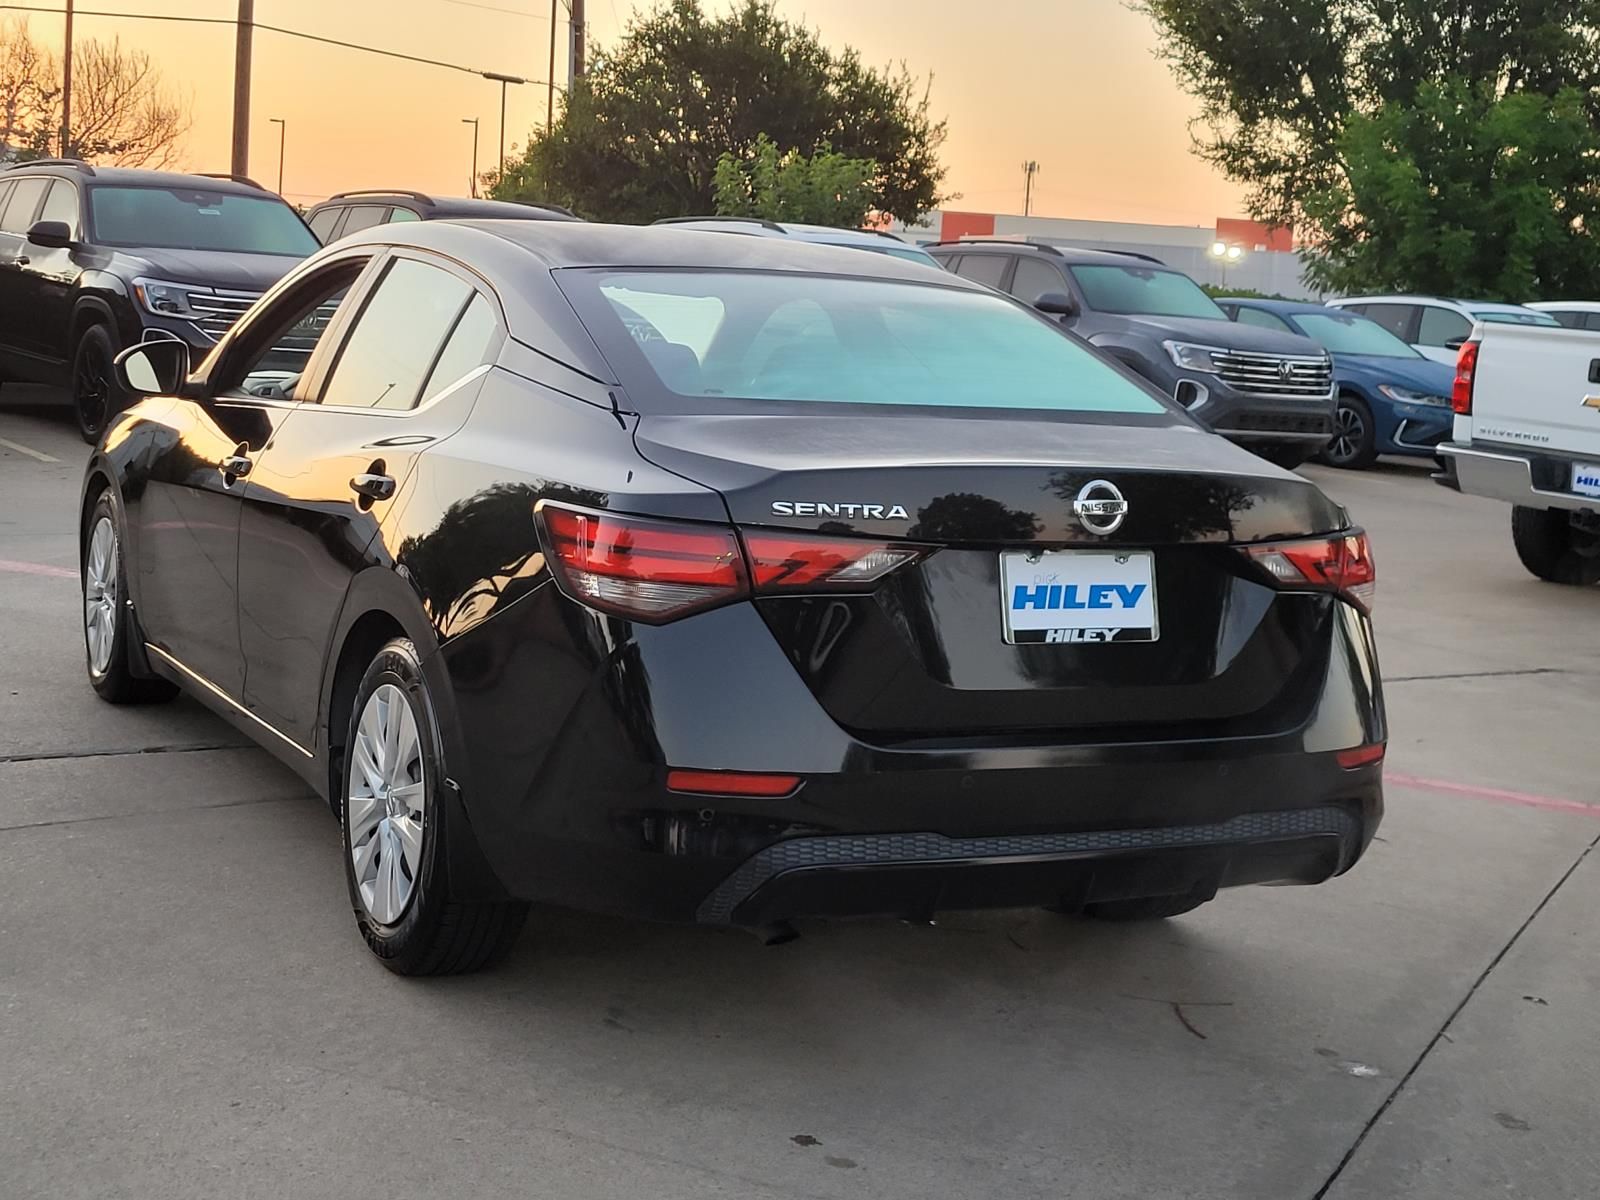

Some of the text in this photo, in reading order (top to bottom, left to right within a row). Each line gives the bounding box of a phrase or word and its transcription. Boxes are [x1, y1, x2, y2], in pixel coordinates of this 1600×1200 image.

[771, 500, 910, 520] SENTRA
[1080, 502, 1124, 513] NISSAN
[1012, 584, 1147, 610] HILEY
[1045, 627, 1121, 643] HILEY
